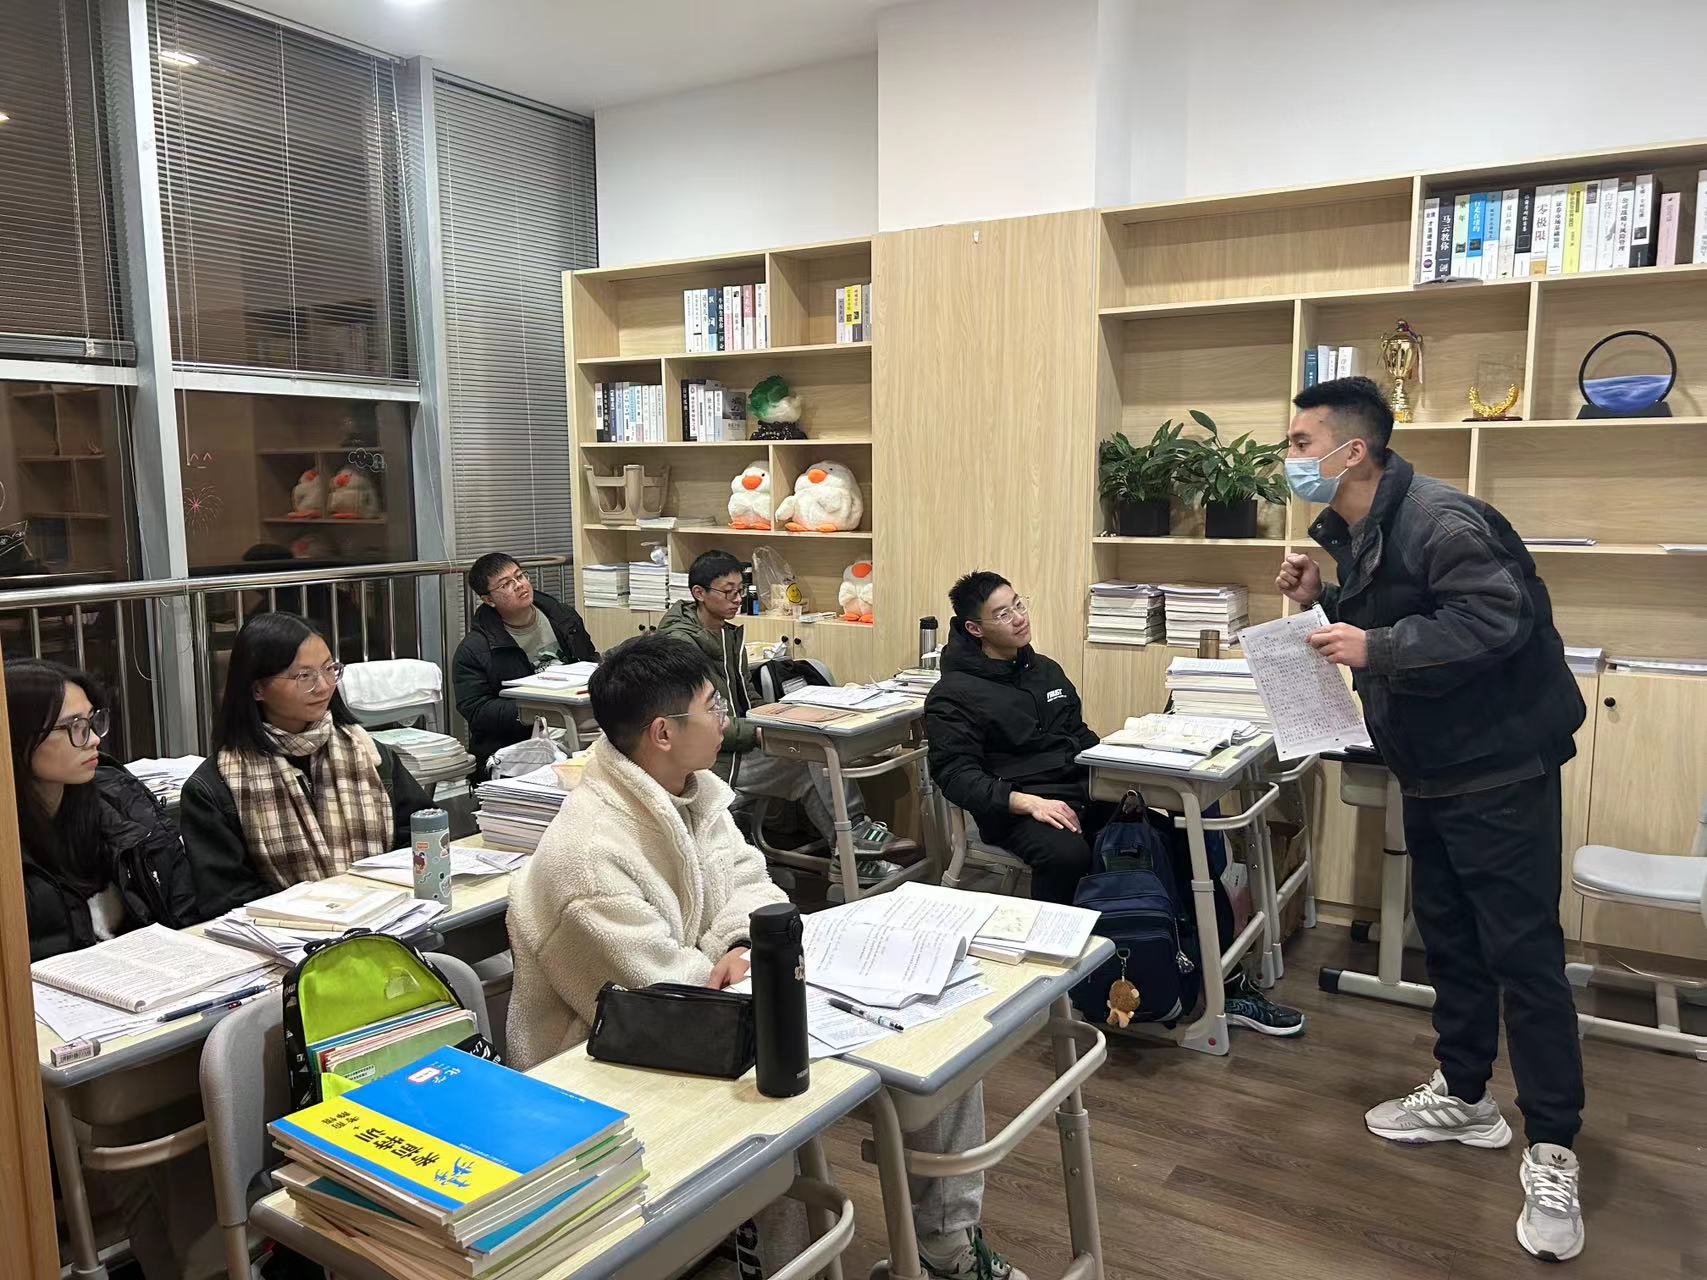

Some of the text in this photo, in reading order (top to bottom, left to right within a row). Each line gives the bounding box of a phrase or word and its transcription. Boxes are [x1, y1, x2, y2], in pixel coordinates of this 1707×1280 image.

[1440, 214, 1452, 251] 马云教你
[1535, 203, 1548, 241] 零极限
[353, 1127, 440, 1167] 考前特训
